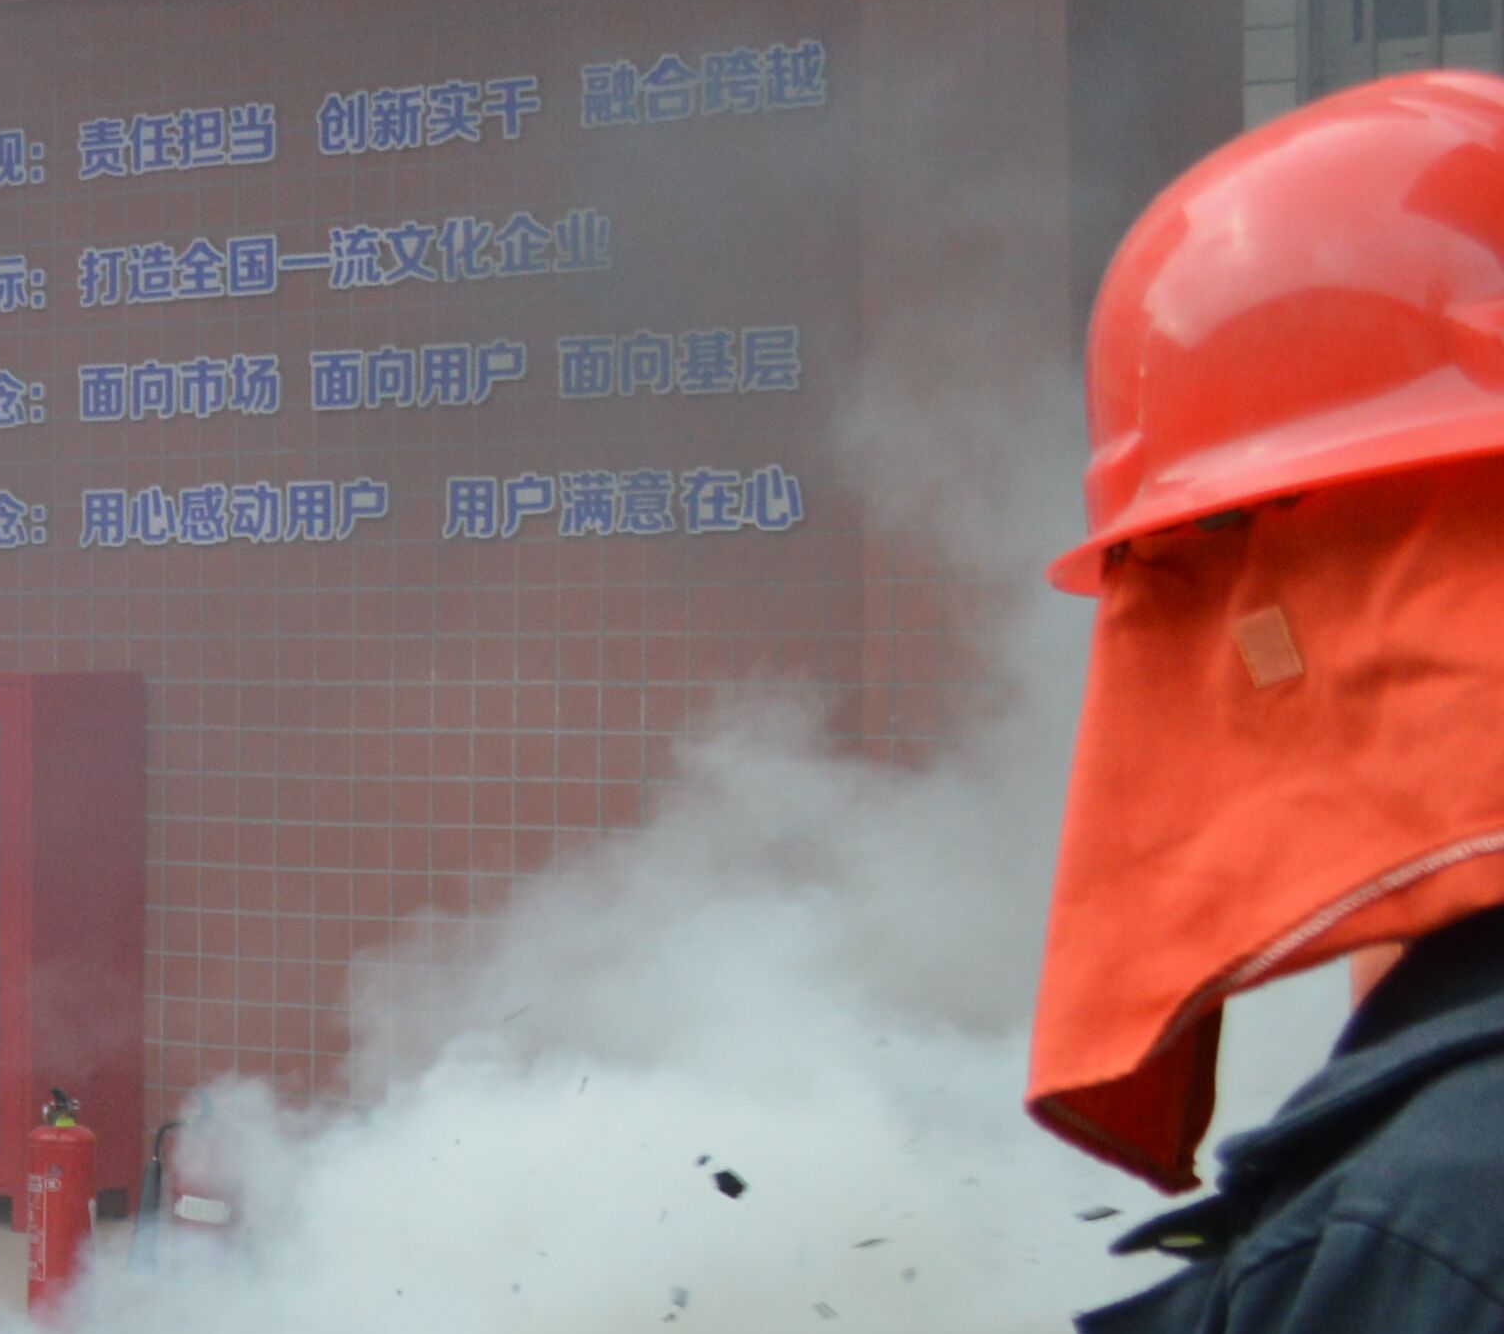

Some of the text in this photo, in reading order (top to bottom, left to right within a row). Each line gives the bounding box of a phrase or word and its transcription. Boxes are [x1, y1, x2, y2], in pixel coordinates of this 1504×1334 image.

[79, 104, 276, 180] 责任担当
[316, 76, 541, 155] 创新实干
[581, 40, 826, 127] 融合跨越
[79, 207, 613, 308] 打造全国一流文化企业
[80, 354, 280, 422] 面向市场
[310, 340, 527, 411] 面向用户
[557, 326, 802, 400] 面向基层
[80, 477, 389, 549] 用心感动用户
[443, 464, 804, 539] 用户满意在心
